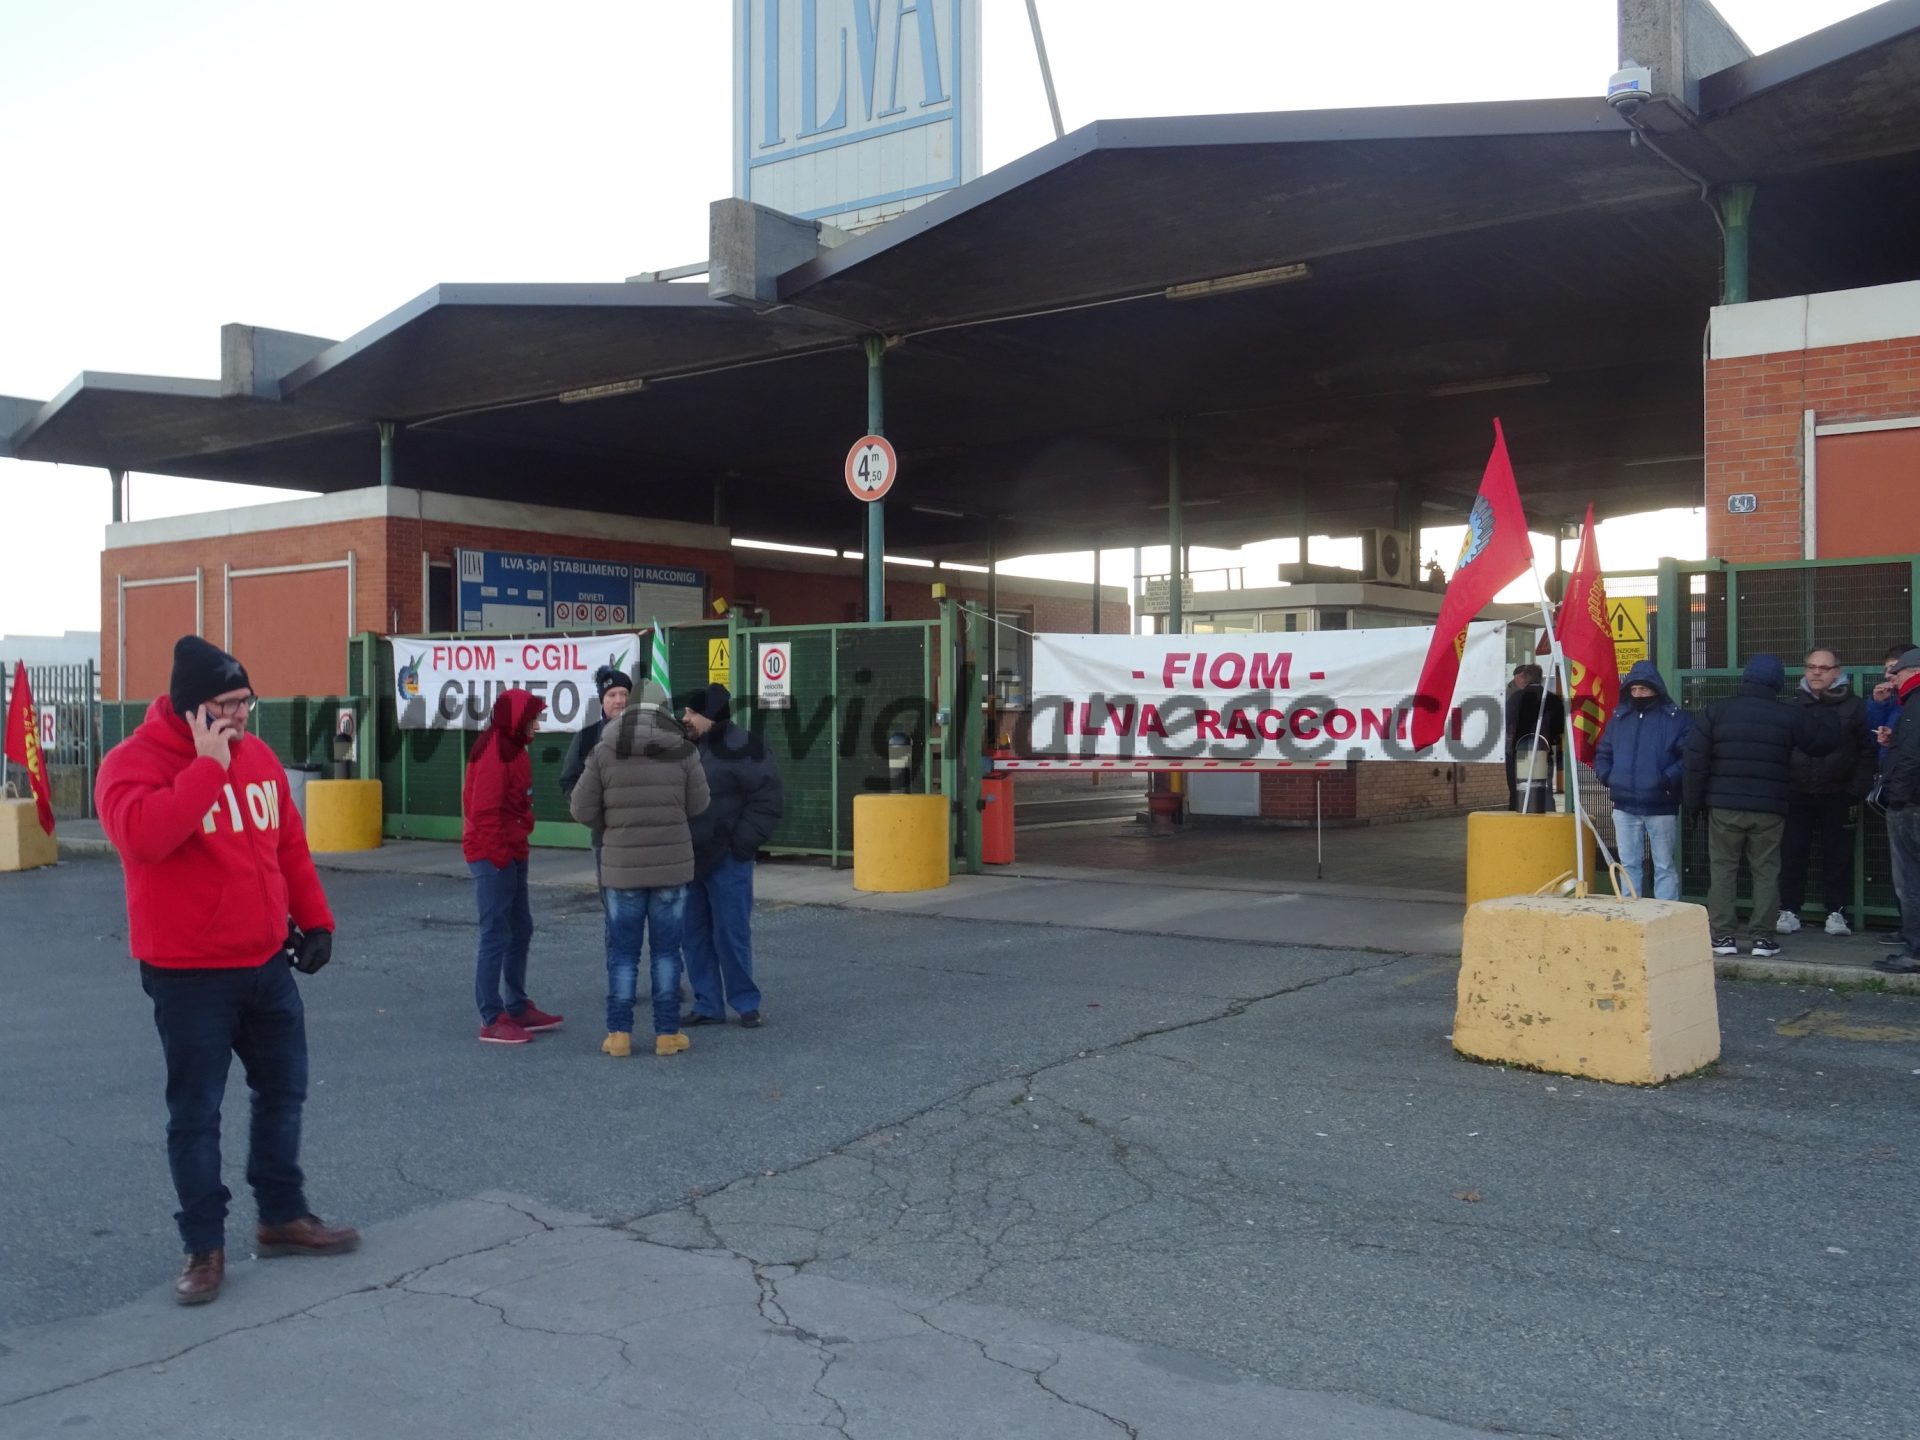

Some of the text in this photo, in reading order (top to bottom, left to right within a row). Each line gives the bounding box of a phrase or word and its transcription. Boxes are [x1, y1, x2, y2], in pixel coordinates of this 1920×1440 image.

[500, 556, 696, 583] ILVA SpA STABILIMENTO DI RACCONIGI
[578, 592, 604, 602] DIVIETI
[433, 645, 496, 671] FIOM
[522, 644, 588, 671] CGIL
[768, 656, 780, 674] 10
[1162, 652, 1293, 690] FIOM
[1063, 702, 1462, 740] ILVA RACCONII
